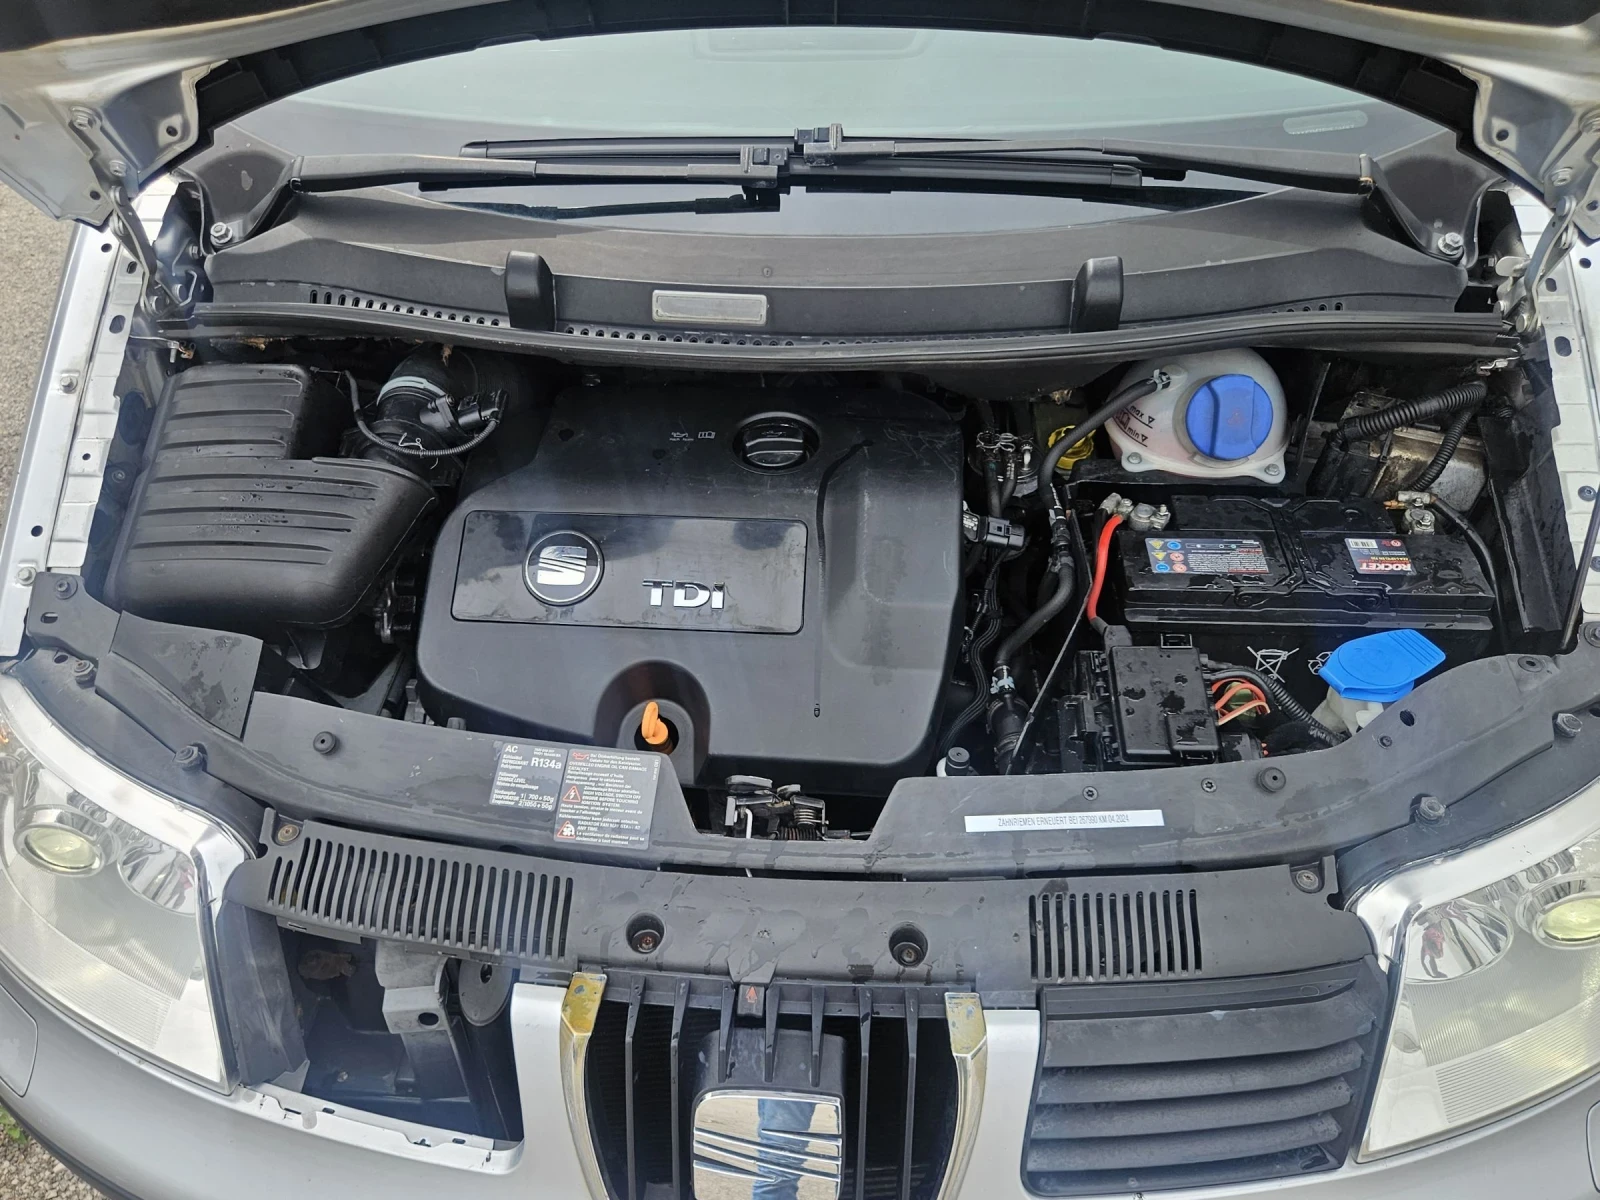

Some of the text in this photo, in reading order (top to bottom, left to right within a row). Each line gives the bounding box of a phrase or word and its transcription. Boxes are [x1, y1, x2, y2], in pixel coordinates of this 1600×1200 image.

[1129, 405, 1145, 418] max
[1127, 427, 1140, 439] min
[1358, 562, 1412, 572] ROCKET
[505, 744, 519, 754] AC
[530, 756, 562, 769] R134a
[998, 816, 1036, 827] ZAHNRIEMEN
[1036, 816, 1067, 825] ERNEUERT
[1068, 815, 1078, 824] BEI
[1099, 814, 1108, 823] KM
